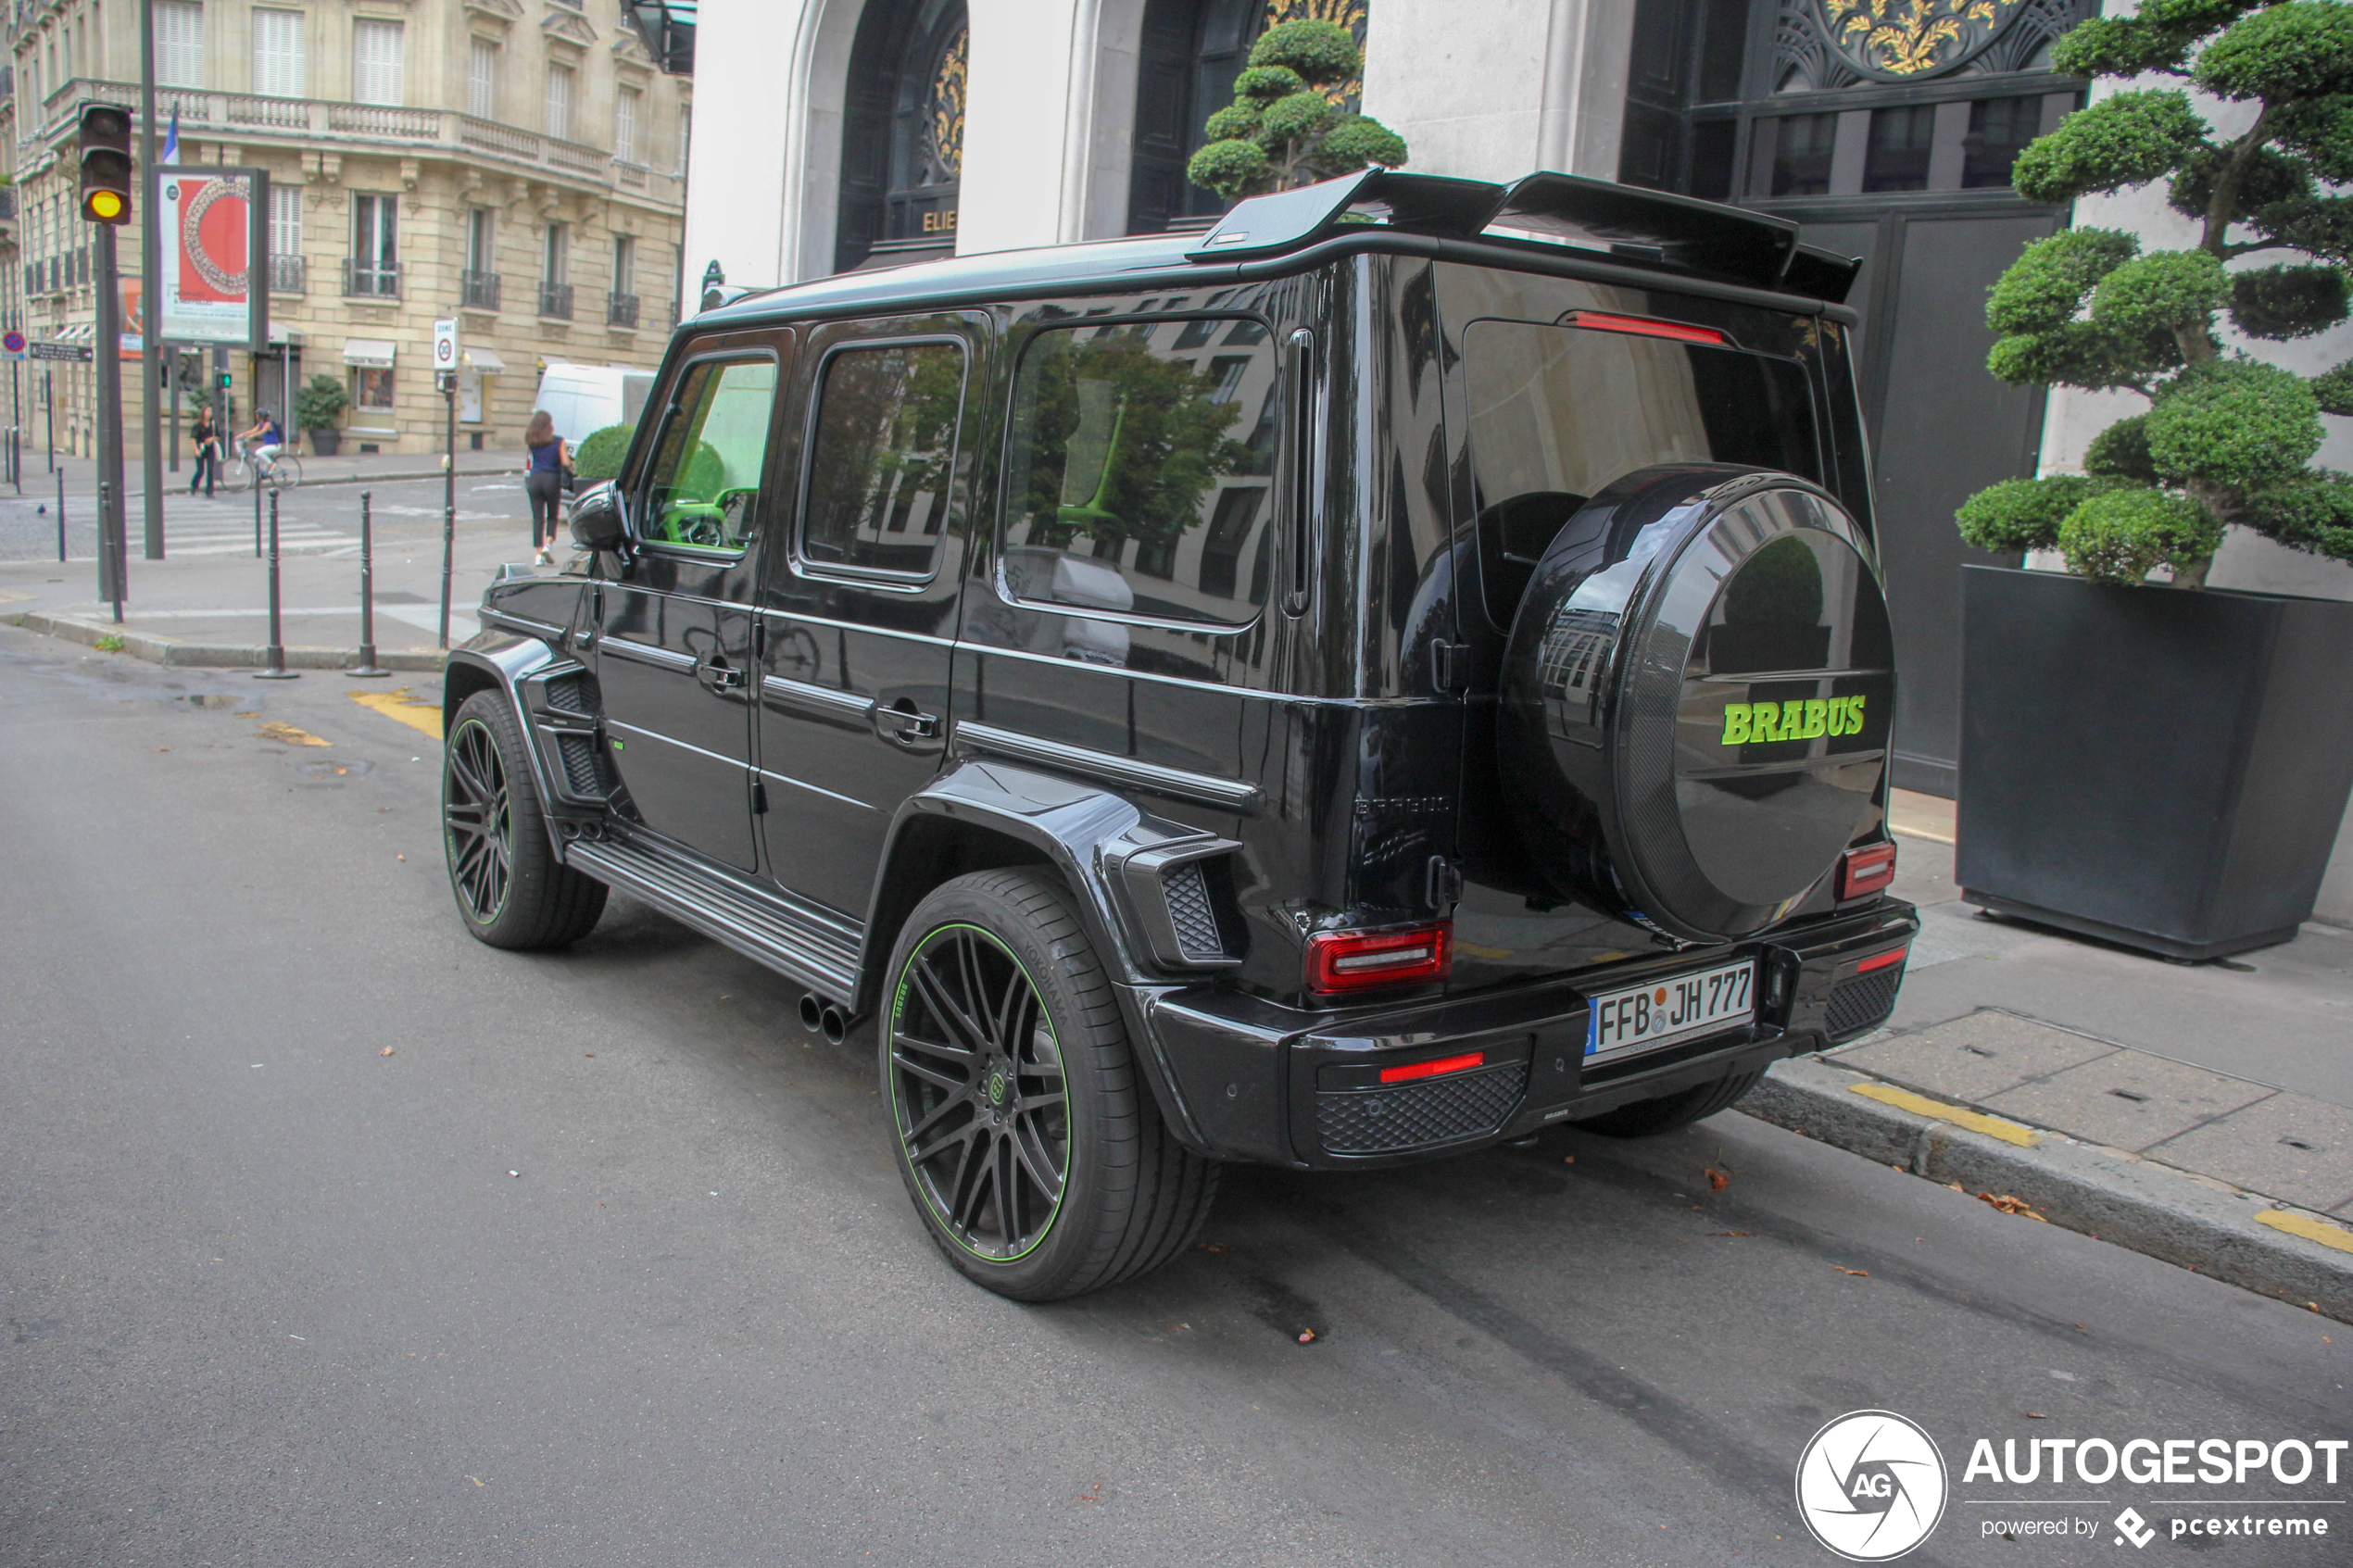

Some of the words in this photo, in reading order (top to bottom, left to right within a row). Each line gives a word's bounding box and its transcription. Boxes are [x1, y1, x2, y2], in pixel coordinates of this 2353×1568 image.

[923, 210, 956, 232] ELIE
[437, 324, 452, 332] ZONE
[441, 345, 449, 355] 30
[1720, 695, 1867, 746] BRABUS
[895, 983, 909, 1019] BRABUS
[1024, 940, 1068, 1026] YOKOHAMA
[1599, 993, 1650, 1046] FFB
[1670, 978, 1703, 1026] JH
[1708, 967, 1752, 1017] 777
